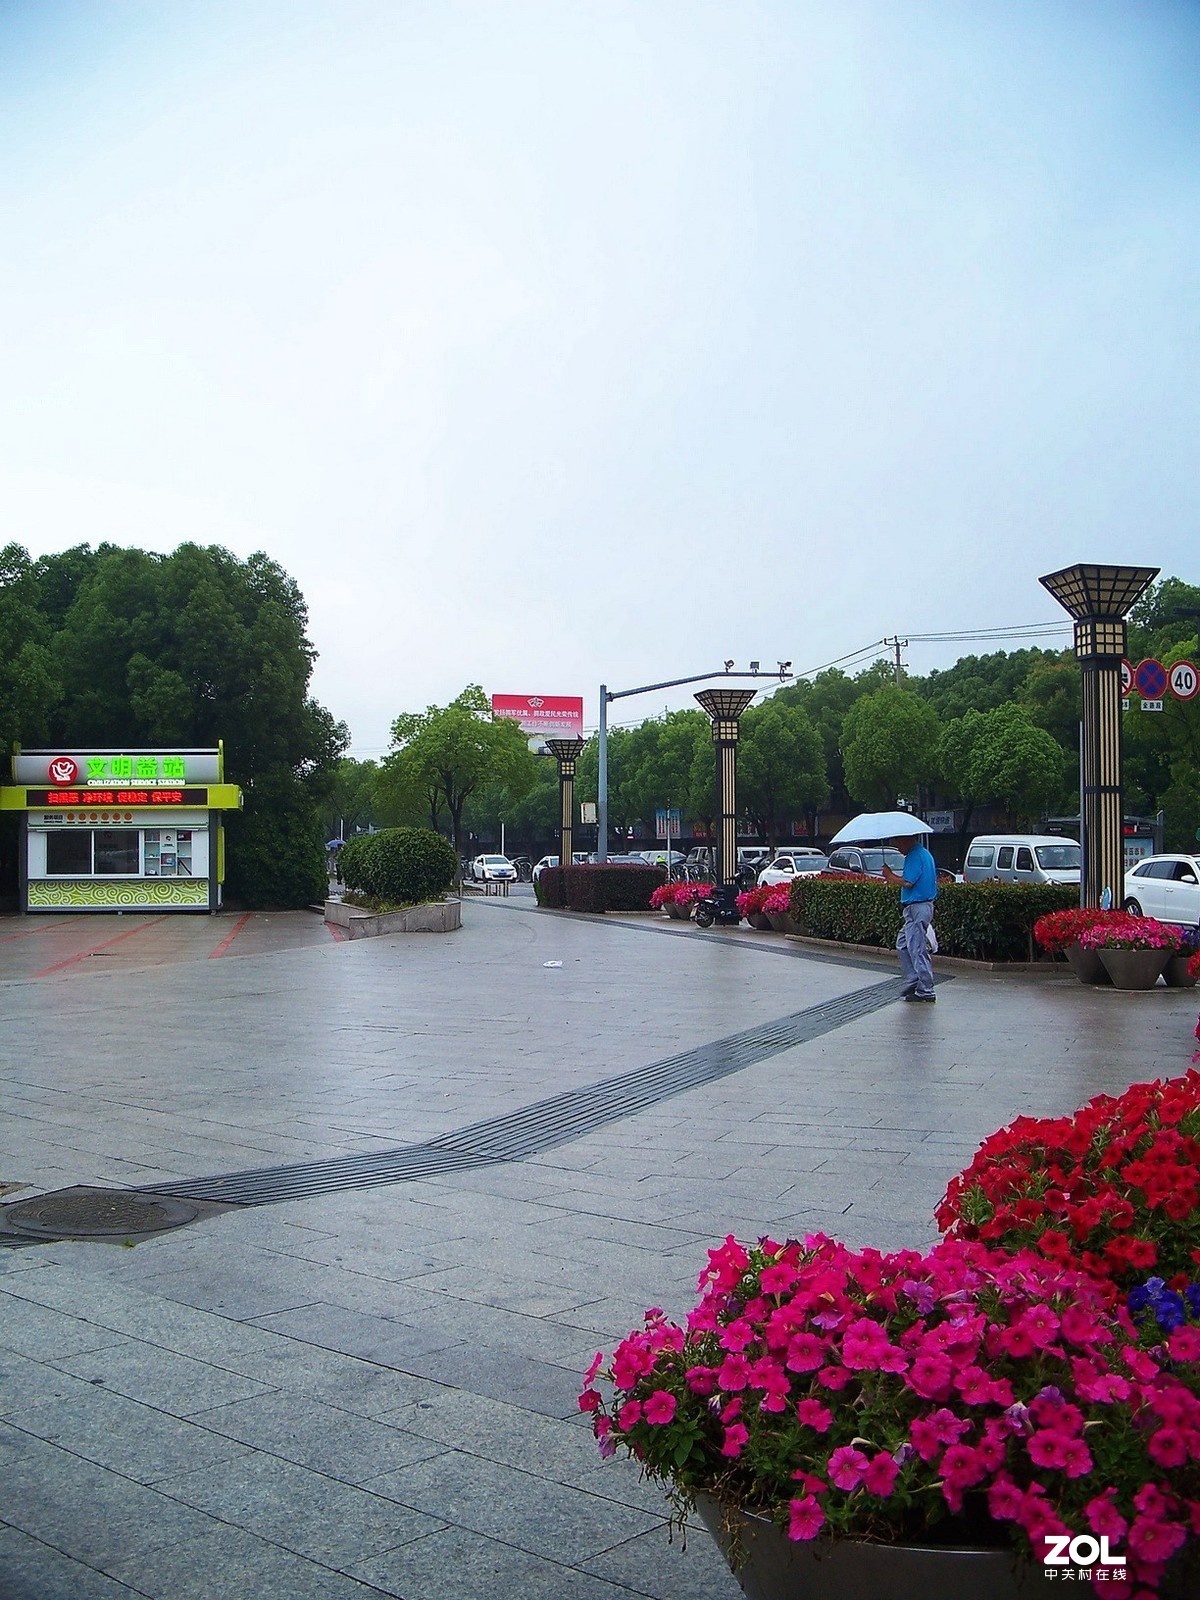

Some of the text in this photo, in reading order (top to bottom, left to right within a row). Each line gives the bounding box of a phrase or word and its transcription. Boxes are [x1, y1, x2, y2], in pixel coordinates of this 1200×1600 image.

[1175, 671, 1192, 689] 40
[87, 757, 185, 778] 文明益站
[83, 792, 113, 802] 净环境
[117, 792, 148, 802] 促稳定
[151, 791, 183, 802] 保平安
